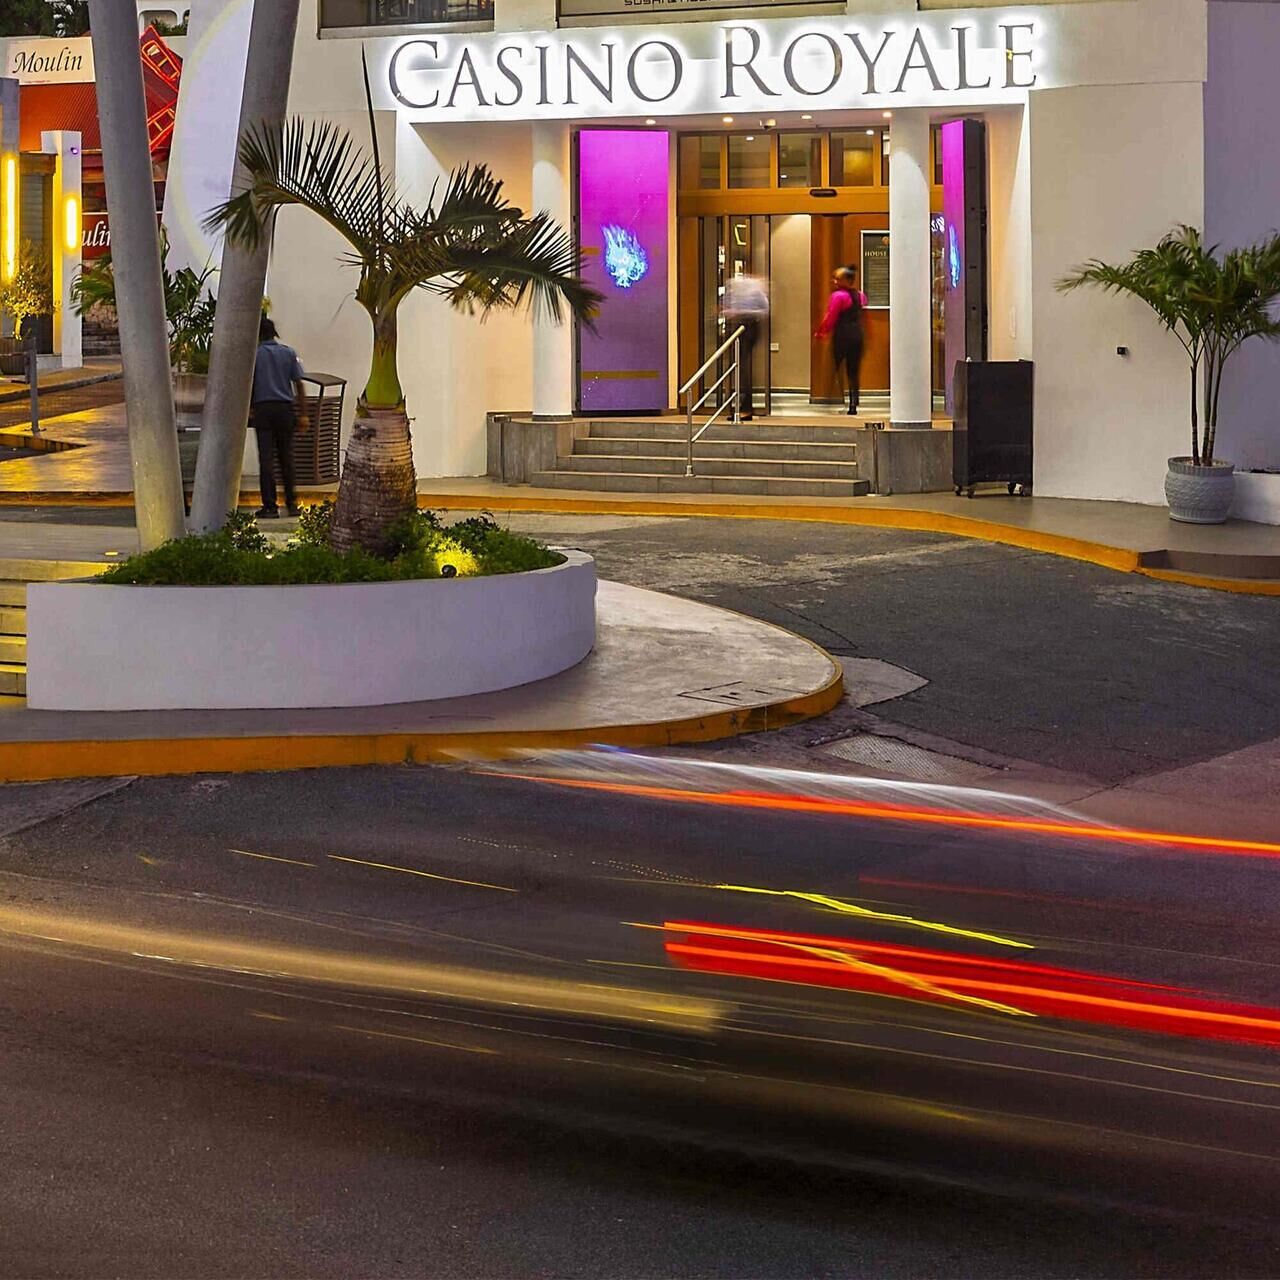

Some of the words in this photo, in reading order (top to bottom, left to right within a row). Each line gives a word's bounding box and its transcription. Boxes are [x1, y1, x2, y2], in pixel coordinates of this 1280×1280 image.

[12, 46, 83, 75] Moulin
[388, 39, 685, 109] CASINO
[719, 21, 1038, 99] ROYALE
[864, 250, 888, 258] HOUSE
